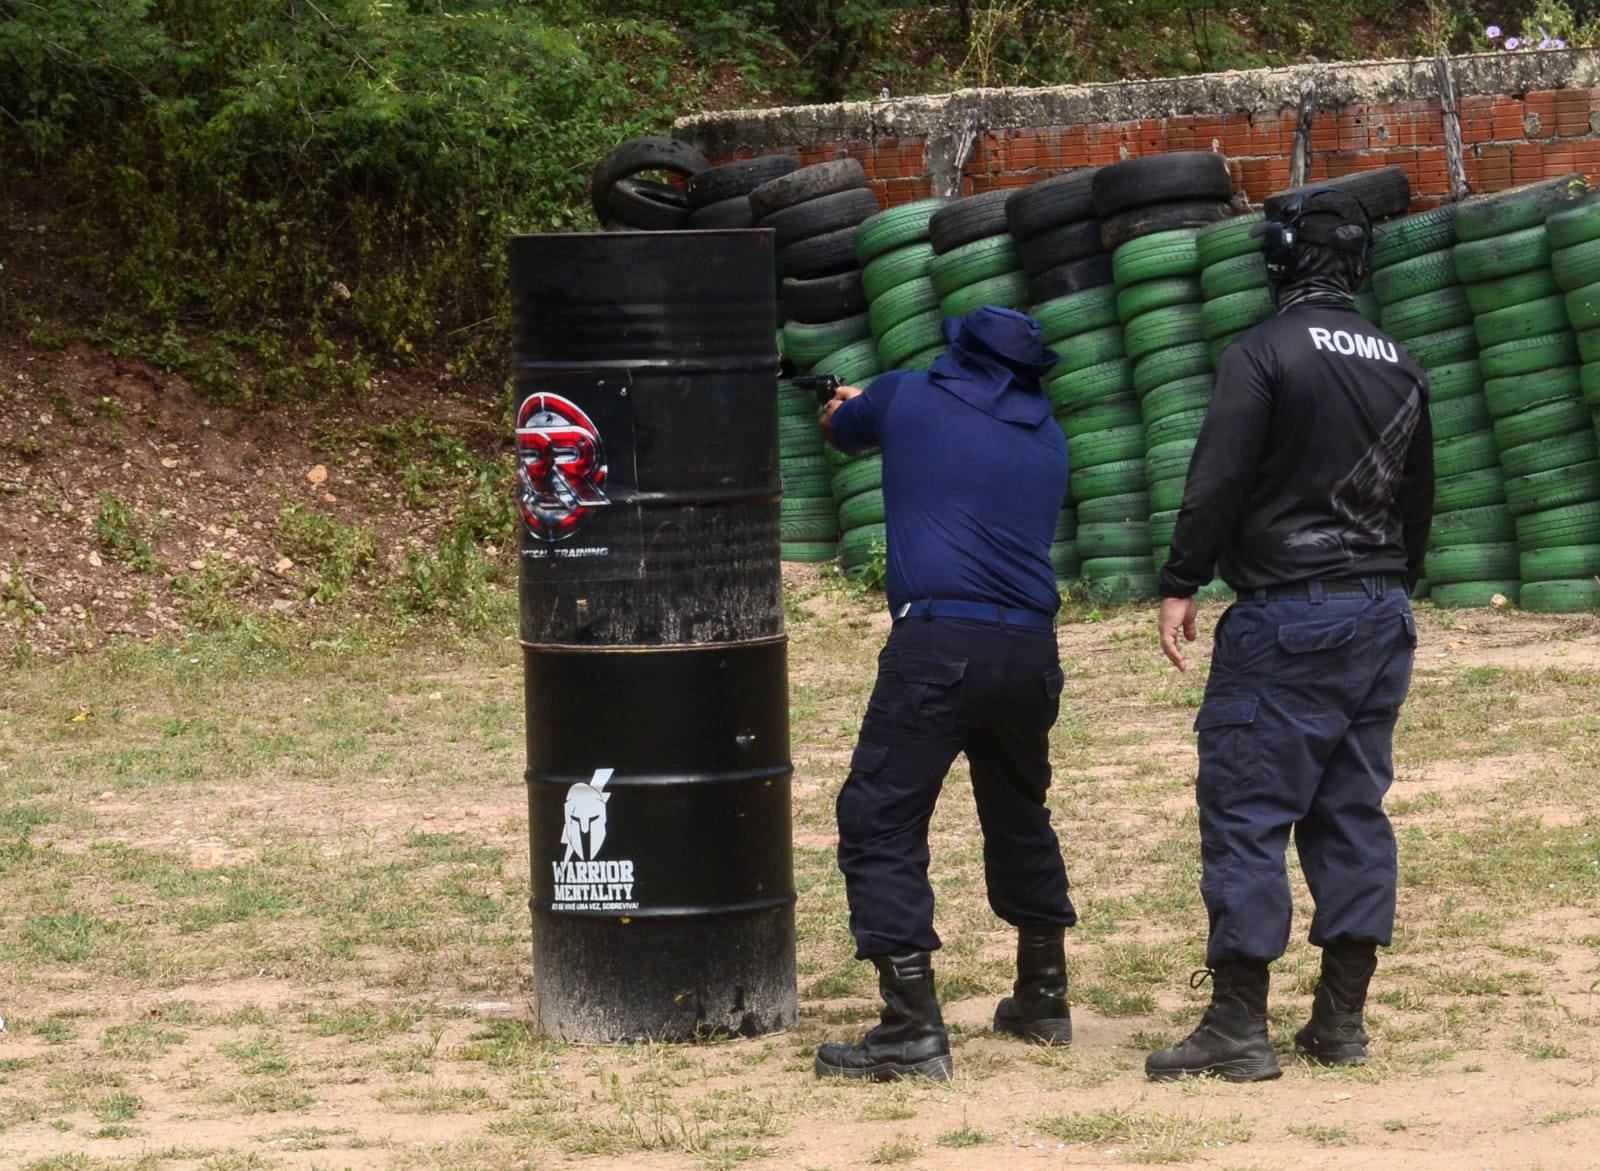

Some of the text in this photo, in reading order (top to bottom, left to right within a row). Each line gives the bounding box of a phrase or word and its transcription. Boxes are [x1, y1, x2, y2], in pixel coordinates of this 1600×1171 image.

[1308, 327, 1399, 363] ROMU
[554, 547, 609, 558] TRAINING
[552, 860, 635, 884] WARRIOR
[554, 884, 633, 901] MENTALITY
